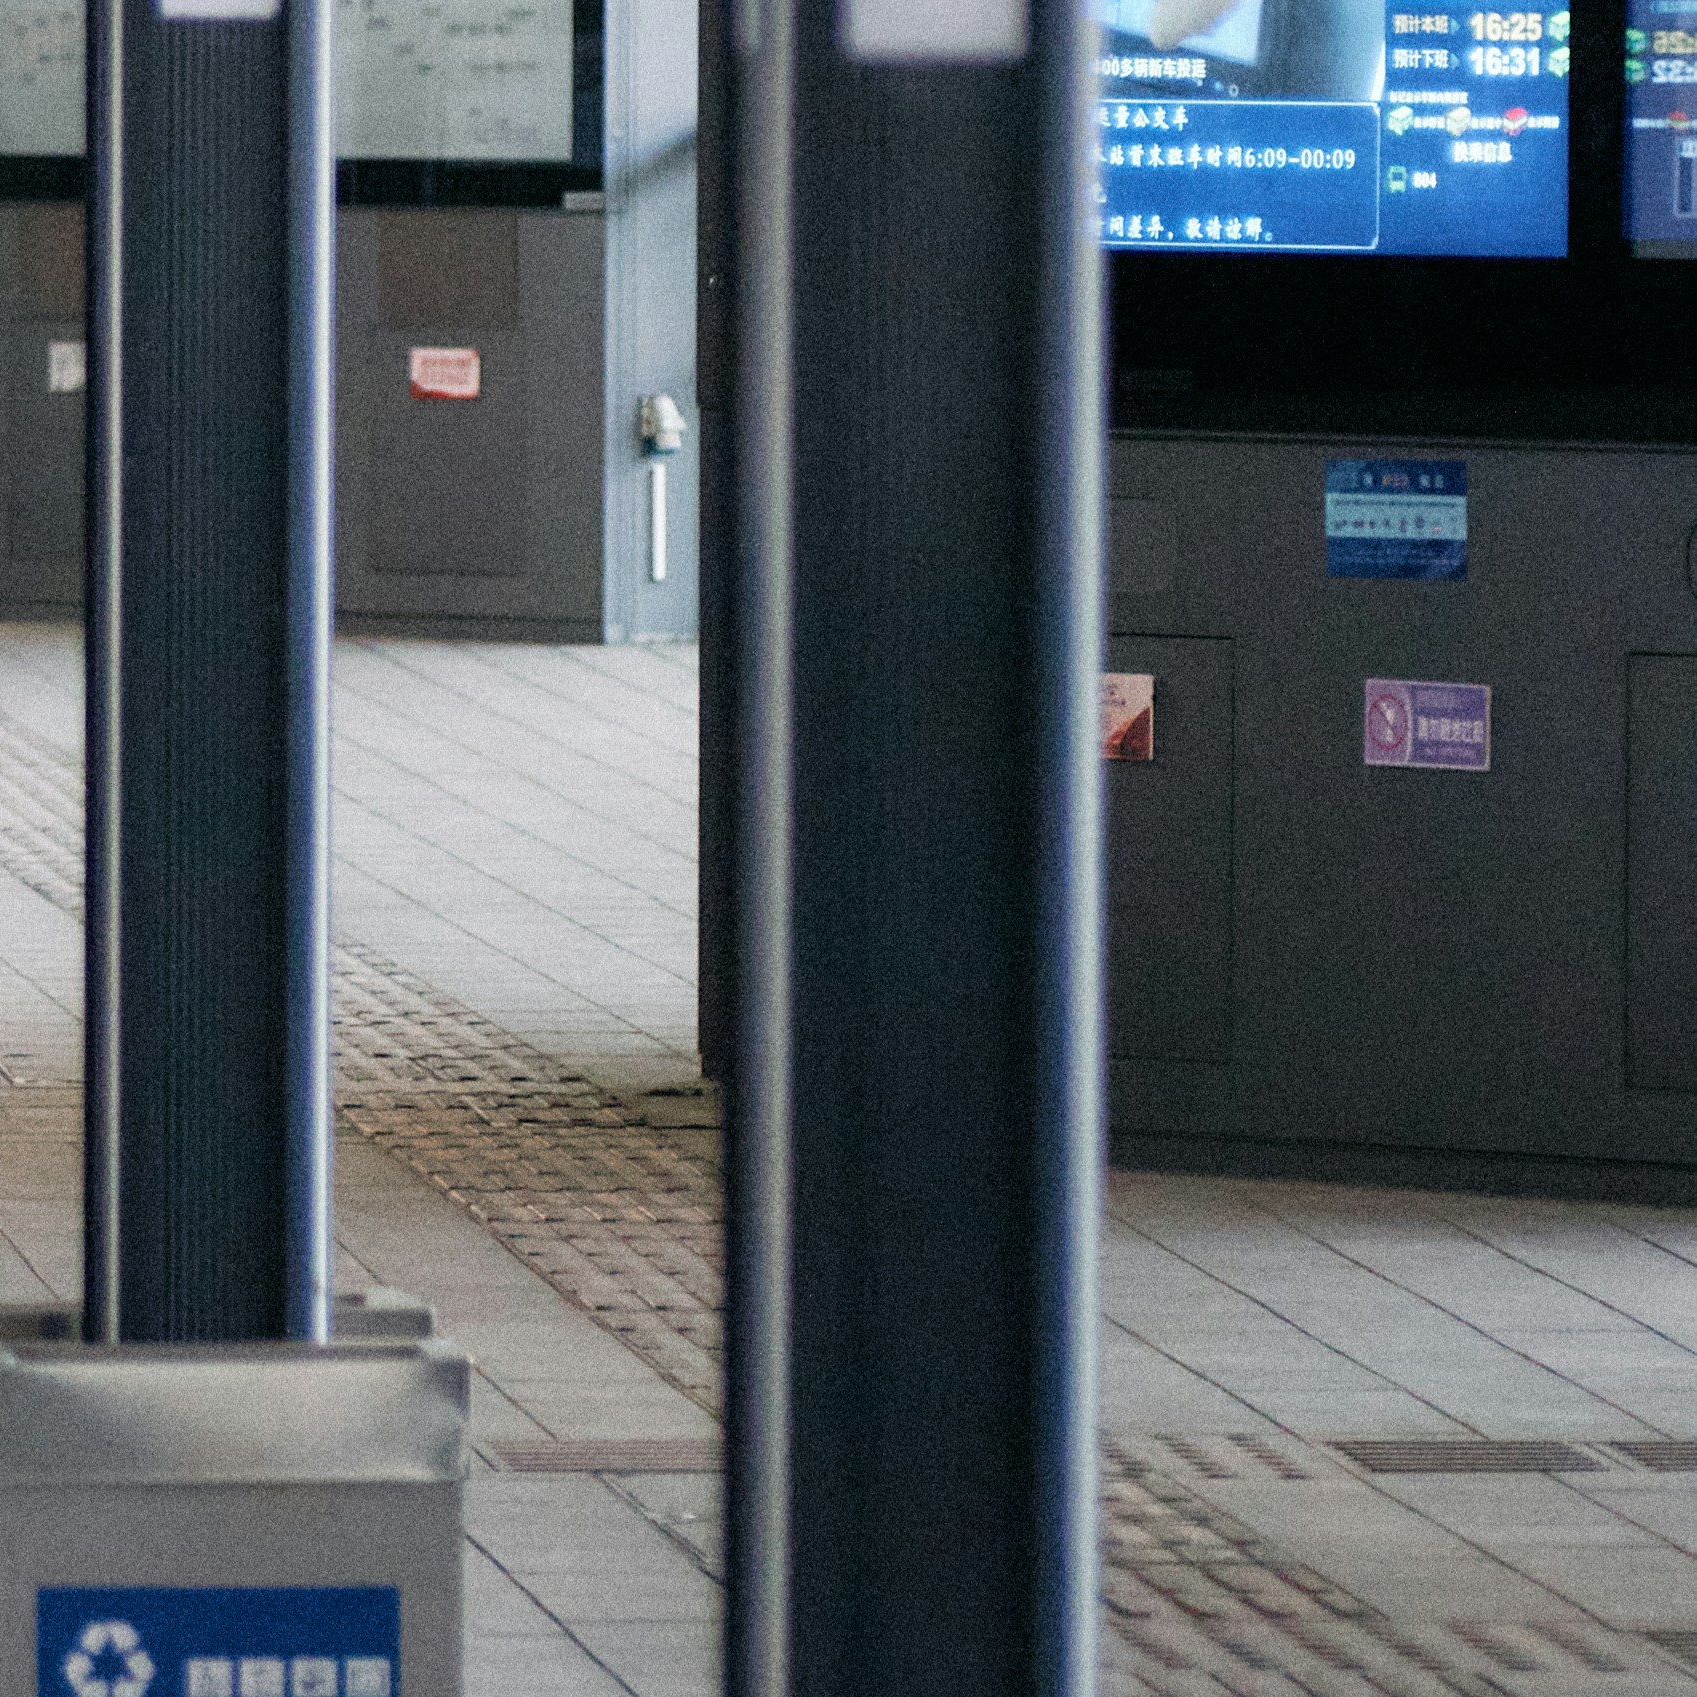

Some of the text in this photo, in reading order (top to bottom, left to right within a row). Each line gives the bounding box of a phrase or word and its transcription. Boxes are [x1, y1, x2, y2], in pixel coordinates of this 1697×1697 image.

[1469, 11, 1543, 42] 16:25
[1094, 57, 1207, 79] 00多辆新车投运
[1469, 46, 1541, 76] 16:31
[1452, 140, 1513, 164] 换乘信息
